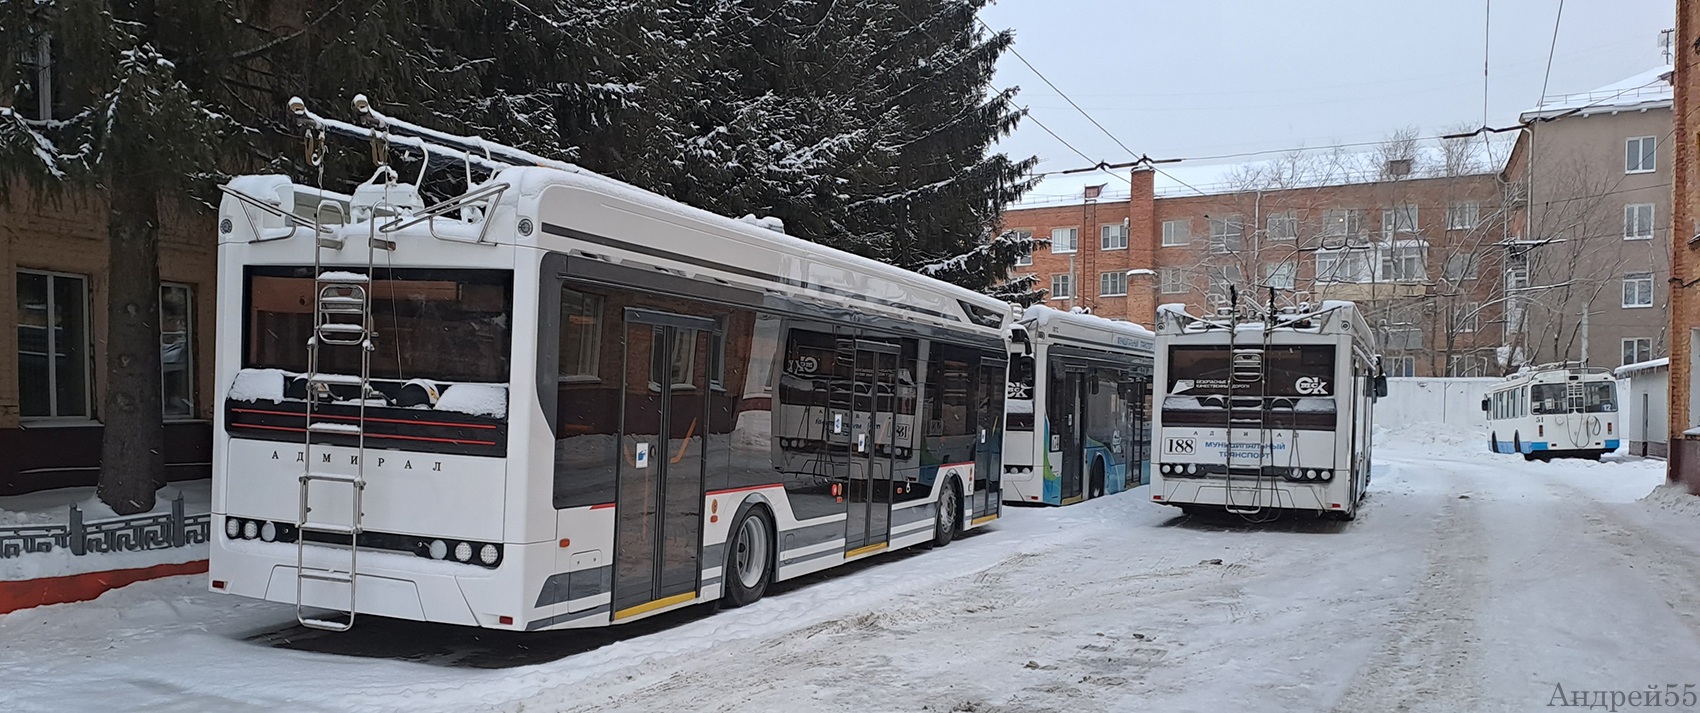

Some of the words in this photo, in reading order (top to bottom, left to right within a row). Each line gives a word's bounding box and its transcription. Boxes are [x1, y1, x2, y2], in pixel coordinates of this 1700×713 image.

[1603, 403, 1612, 412] 12
[1193, 430, 1299, 438] АДИАЛ
[1168, 438, 1194, 453] 188
[271, 450, 441, 472] АДМИРАЛ
